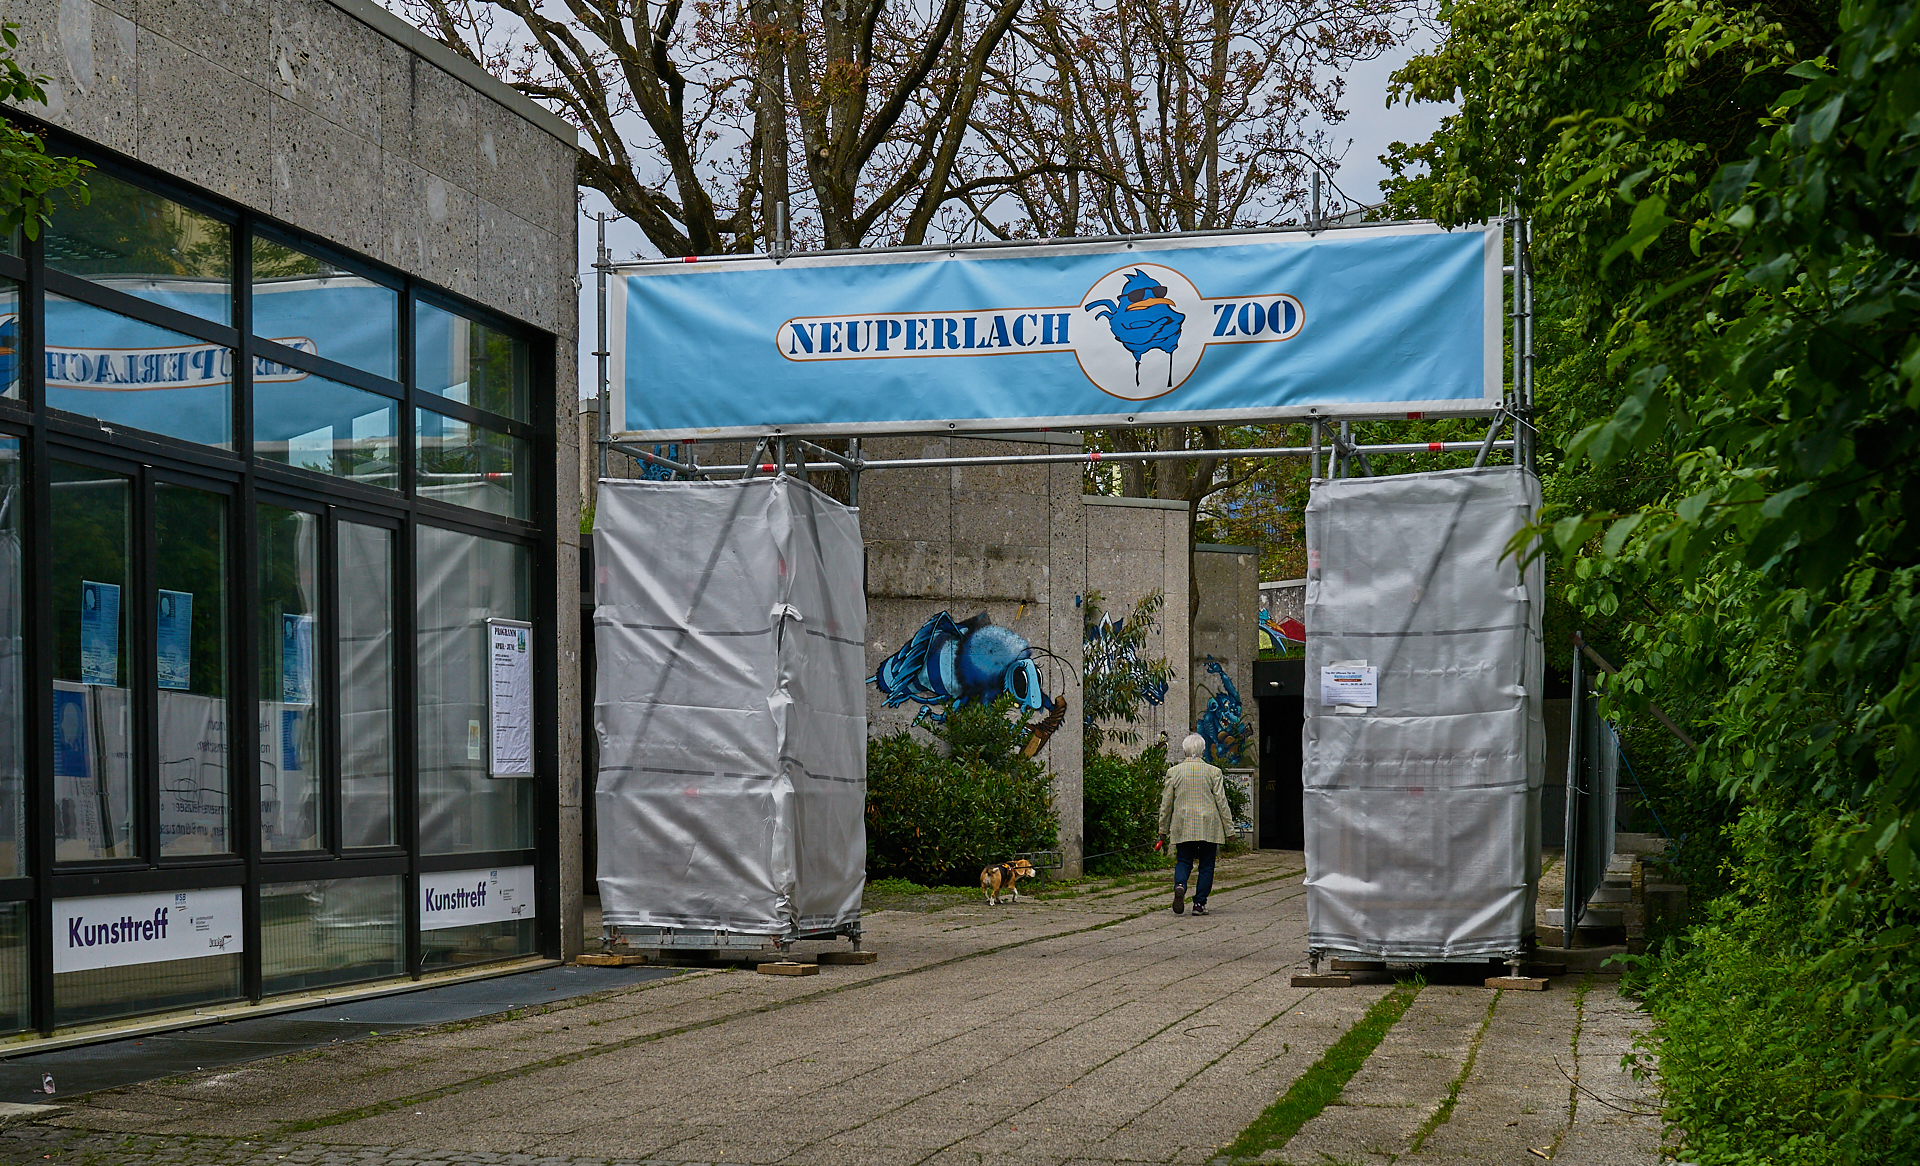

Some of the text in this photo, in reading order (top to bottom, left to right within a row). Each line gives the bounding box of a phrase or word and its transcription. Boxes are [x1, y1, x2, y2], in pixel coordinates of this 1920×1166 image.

[788, 299, 1297, 355] NEUPERLACH ZOO
[425, 881, 487, 912] Kunsttreff
[68, 907, 168, 948] Kunsttreff
